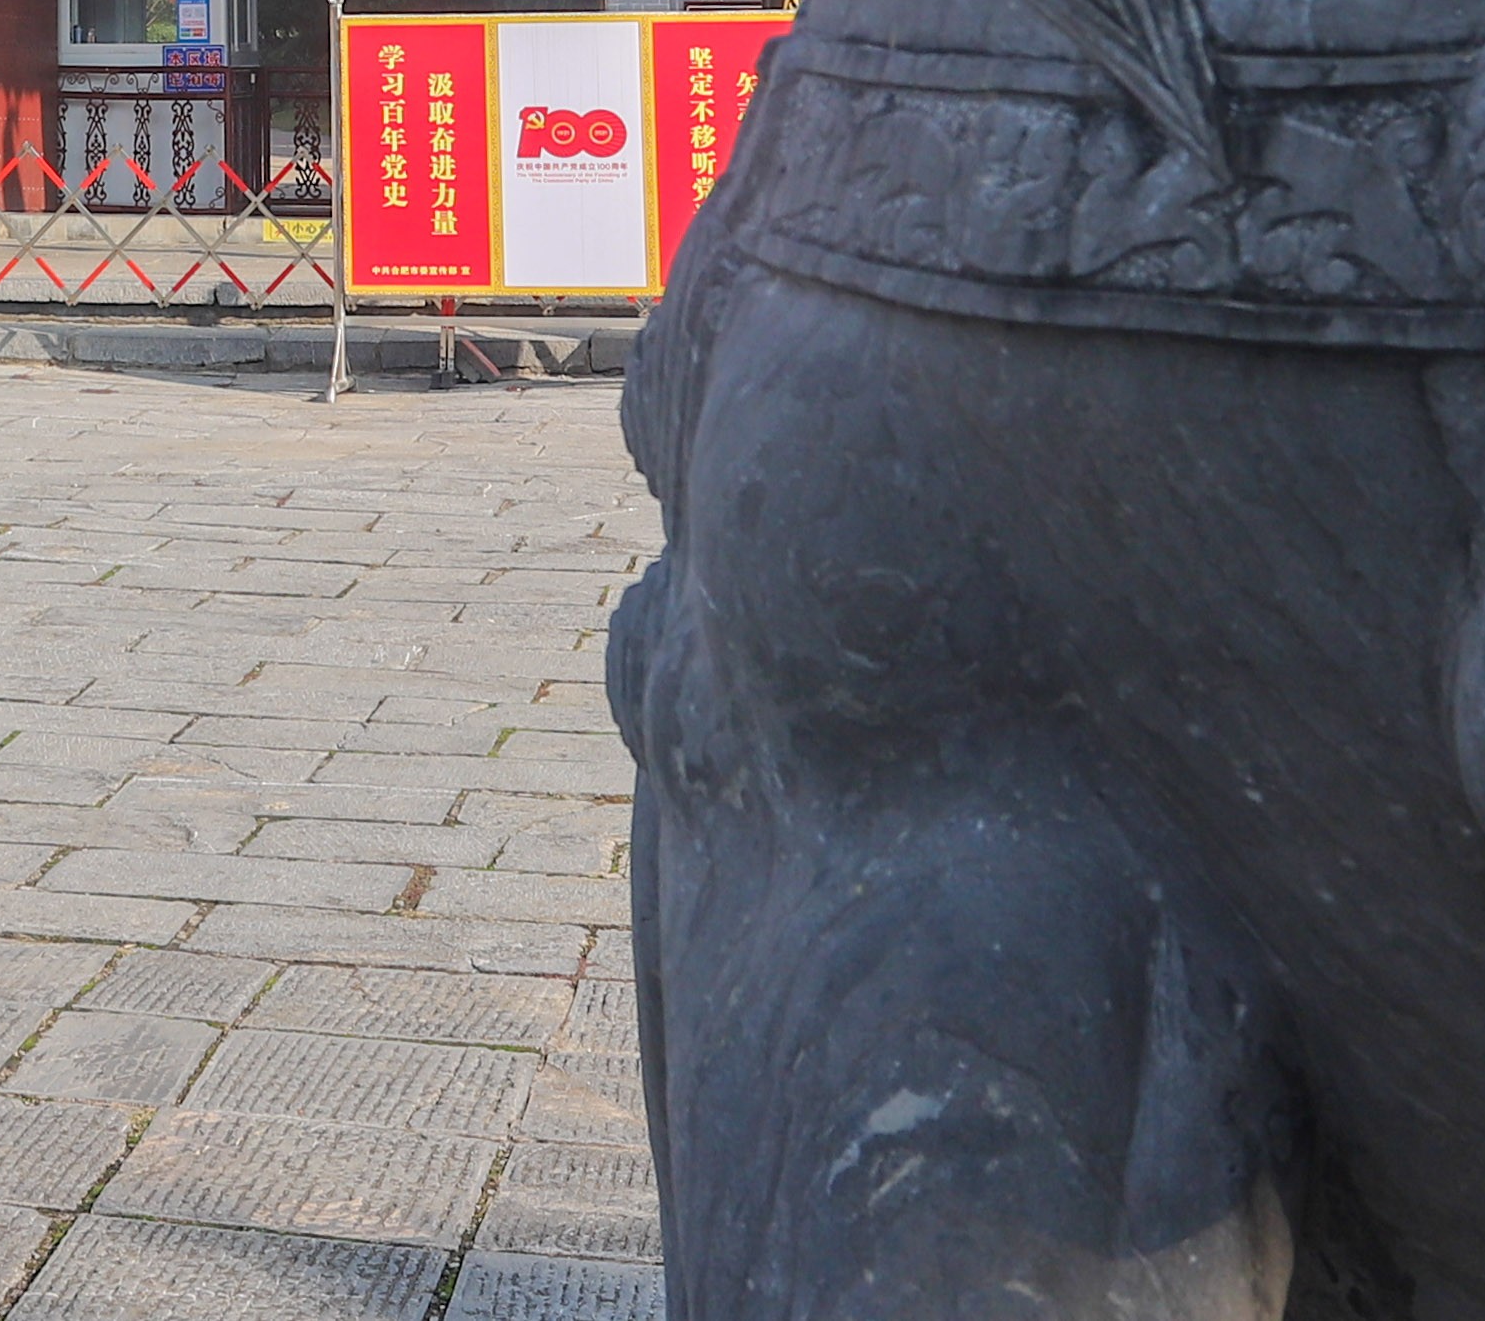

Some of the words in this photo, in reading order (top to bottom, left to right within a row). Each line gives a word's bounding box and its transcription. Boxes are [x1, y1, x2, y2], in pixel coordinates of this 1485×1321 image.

[167, 51, 221, 66] 本区域
[378, 45, 409, 207] 学习百年党史
[689, 47, 718, 215] 坚定不移听党
[428, 72, 458, 236] 汲取奋进力量
[371, 265, 458, 276] 中共合肥市委宣传部
[461, 265, 471, 276] 宣
